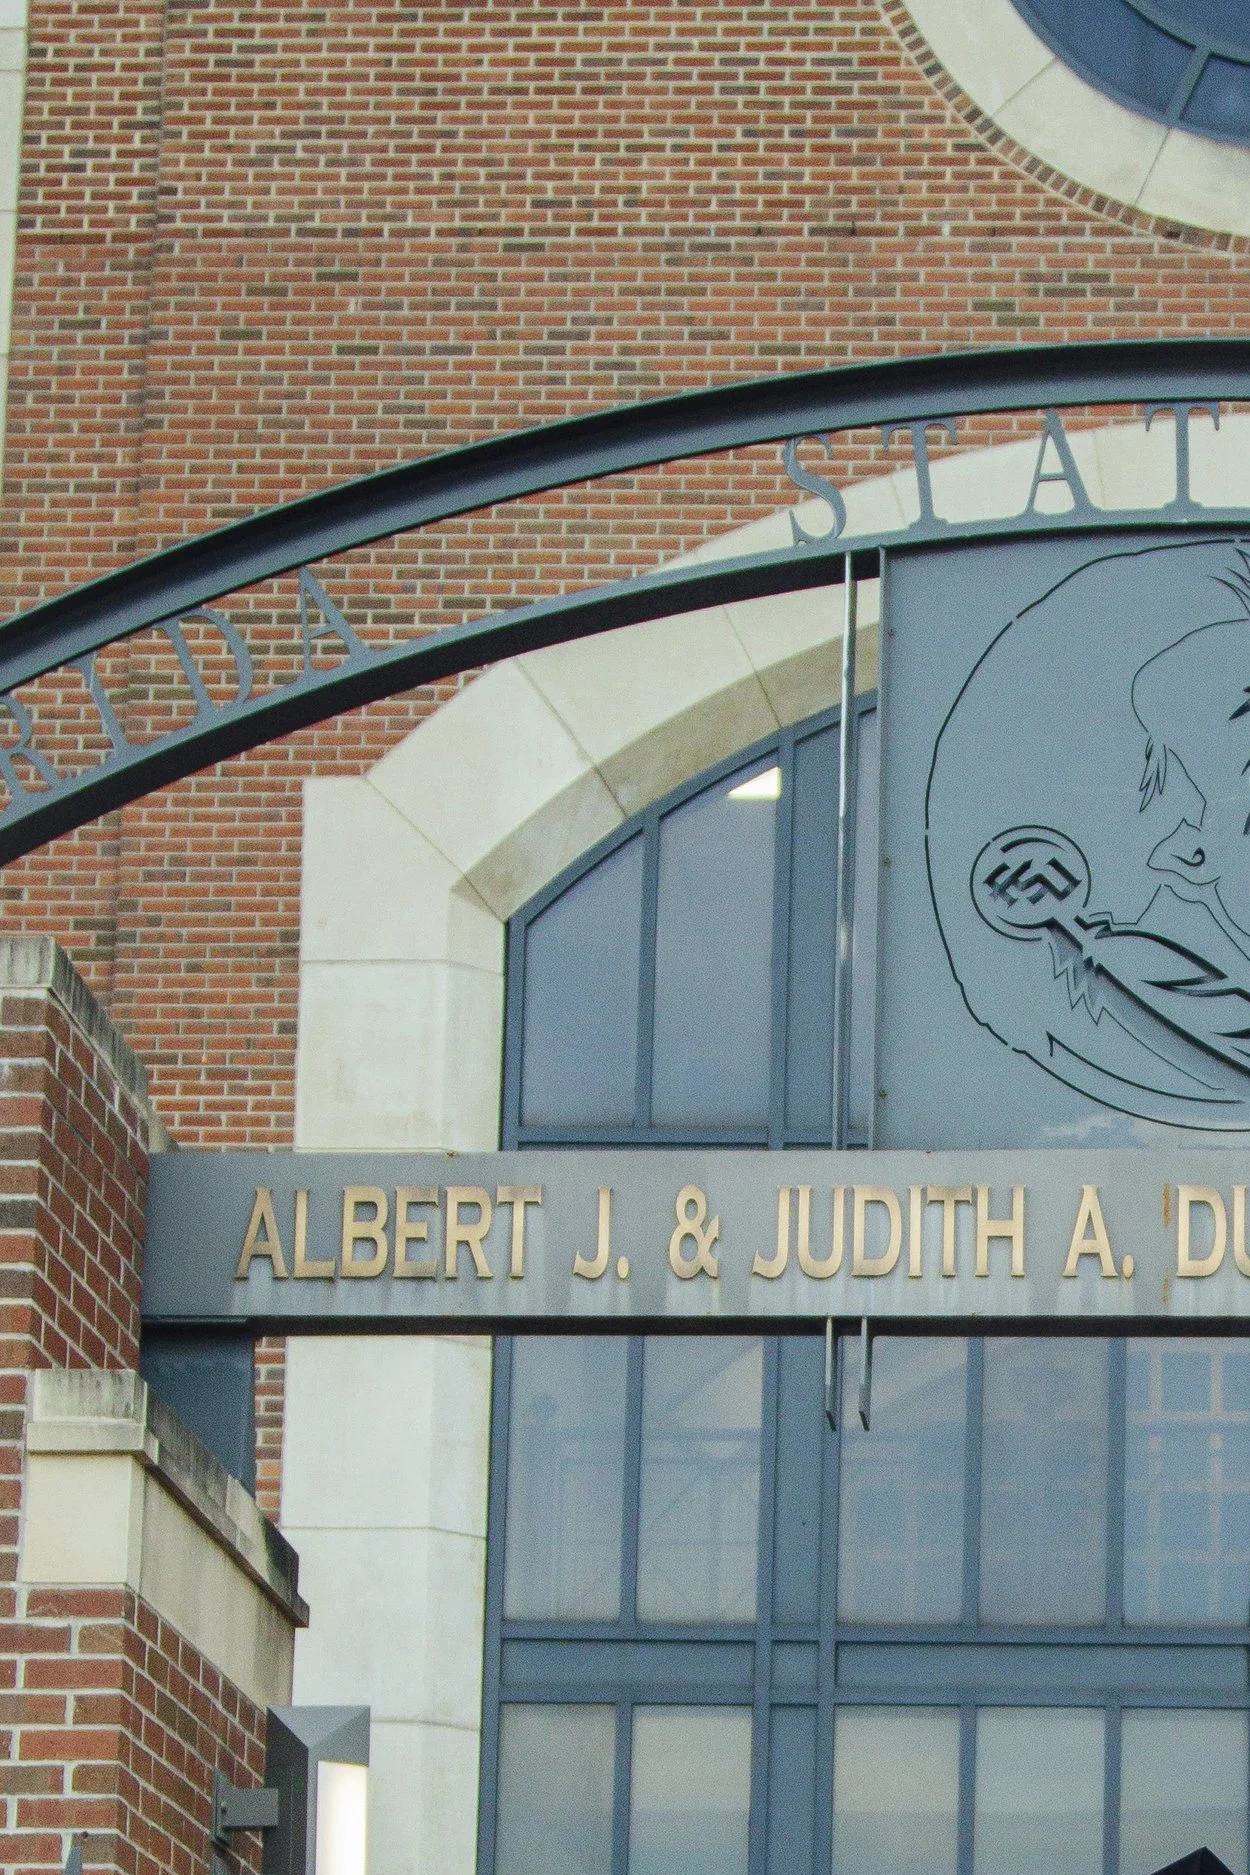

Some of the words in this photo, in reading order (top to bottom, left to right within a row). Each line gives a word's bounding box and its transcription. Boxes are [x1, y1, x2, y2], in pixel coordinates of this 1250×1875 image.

[233, 1185, 543, 1280] ALBERT
[573, 1184, 630, 1280] J.
[668, 1184, 719, 1280] &
[752, 1184, 1026, 1280] JUDITH
[1062, 1184, 1135, 1280] A.
